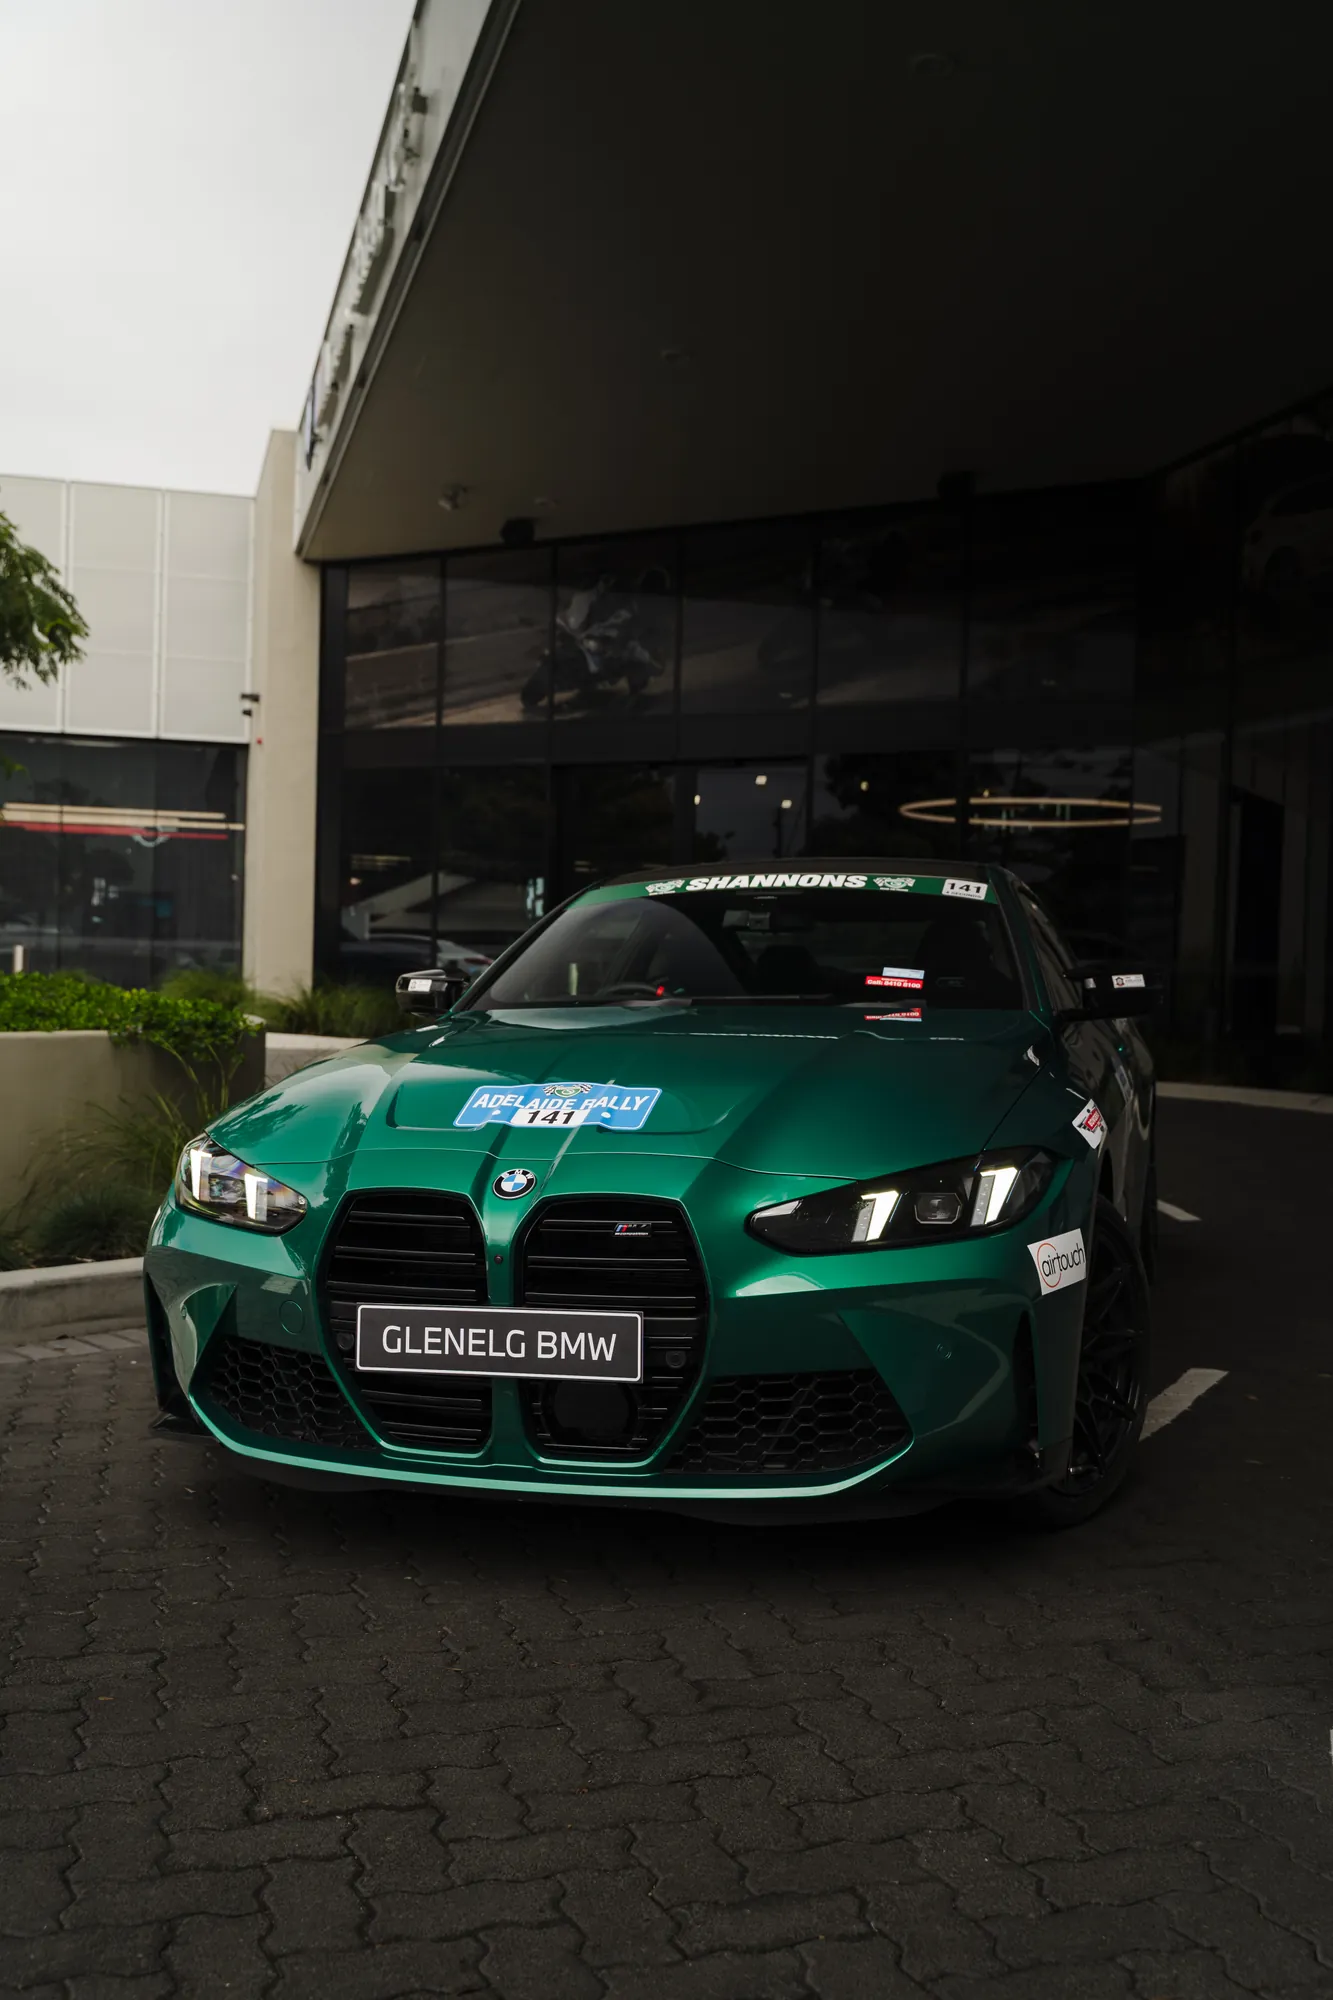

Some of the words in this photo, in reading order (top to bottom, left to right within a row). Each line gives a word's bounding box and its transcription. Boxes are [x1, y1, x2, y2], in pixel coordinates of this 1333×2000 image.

[685, 874, 868, 891] SHANNONS
[948, 882, 982, 894] 141
[472, 1093, 577, 1110] ADELAIDE
[580, 1095, 650, 1111] RALLY
[527, 1110, 576, 1124] 141
[1042, 1243, 1086, 1277] airtouch
[382, 1325, 526, 1358] GLENELG
[537, 1331, 617, 1361] BMW
